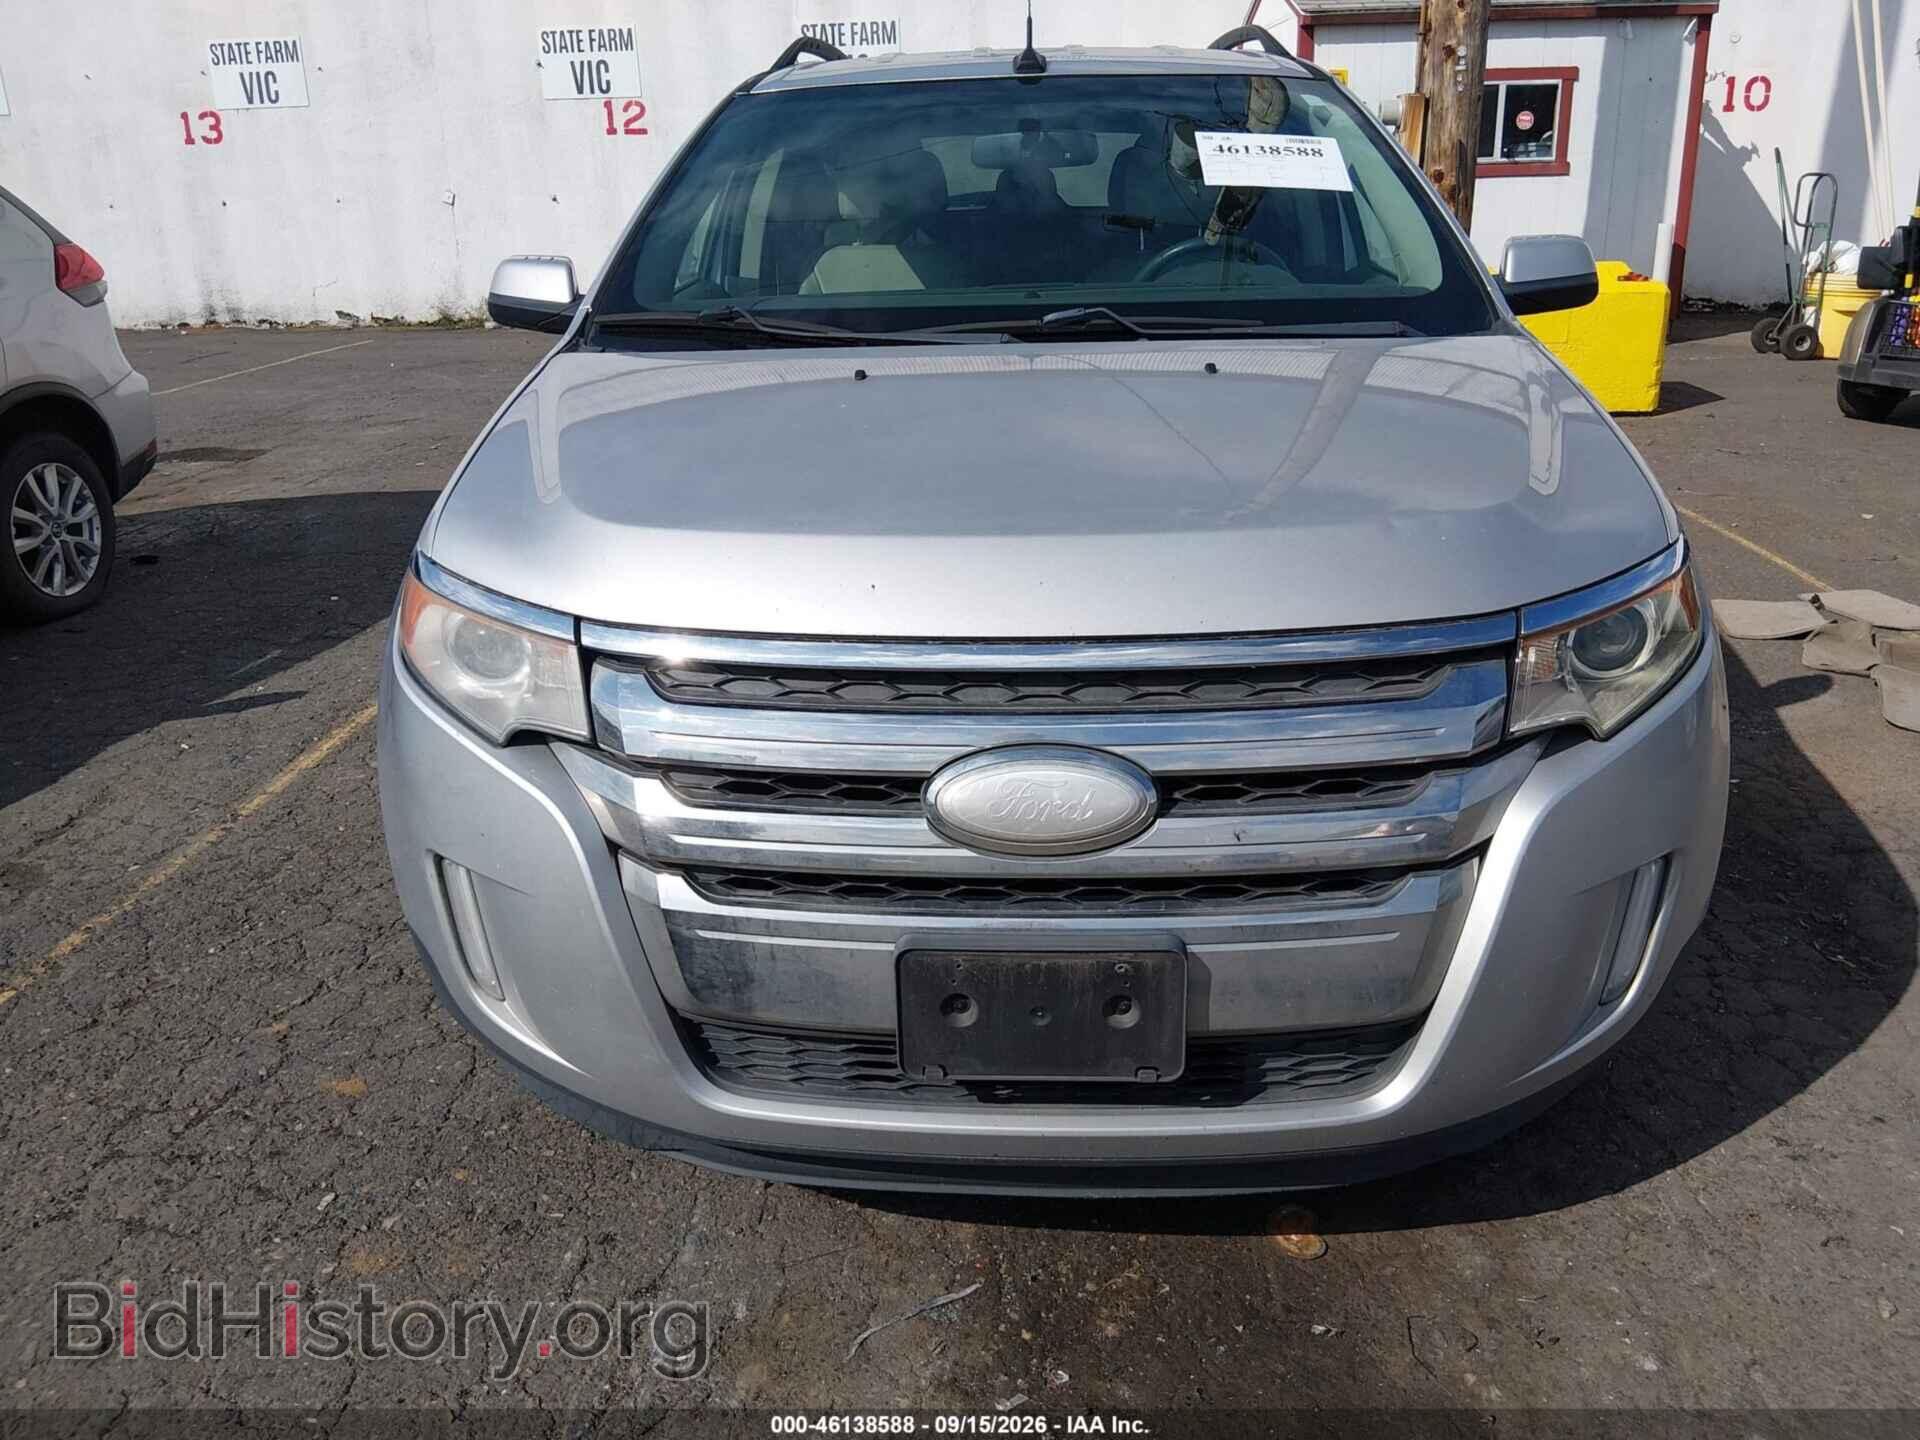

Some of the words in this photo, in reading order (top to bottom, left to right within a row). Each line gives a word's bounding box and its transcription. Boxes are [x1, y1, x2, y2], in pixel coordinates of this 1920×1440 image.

[540, 29, 585, 54] STATE
[588, 27, 634, 52] FARM
[850, 20, 897, 46] FARM
[209, 42, 253, 66] STATE
[255, 39, 300, 64] FARM
[239, 70, 280, 105] VIC
[569, 59, 611, 95] VIC
[1722, 75, 1772, 113] 10
[180, 110, 224, 145] 13
[603, 100, 648, 135] 12
[1211, 143, 1325, 158] 46138588
[985, 777, 1097, 824] Ford
